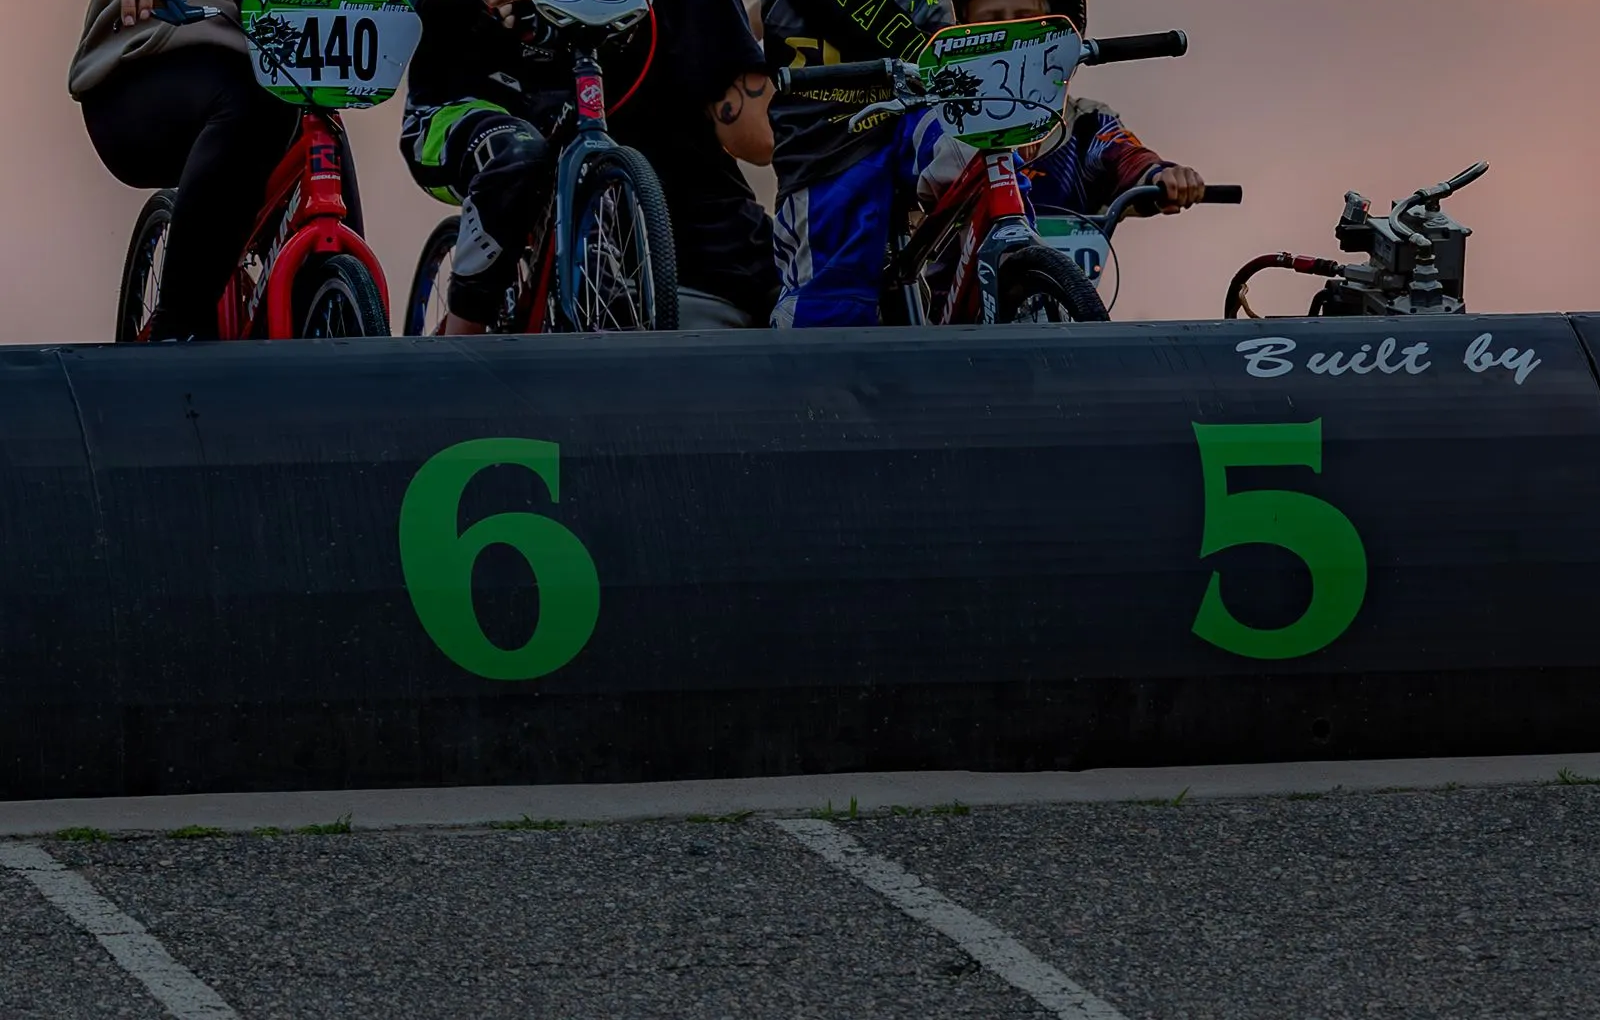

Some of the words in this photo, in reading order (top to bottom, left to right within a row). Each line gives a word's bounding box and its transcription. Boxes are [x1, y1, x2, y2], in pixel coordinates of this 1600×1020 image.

[295, 15, 379, 82] 440
[345, 86, 380, 97] 2022
[1236, 332, 1430, 378] Built
[1464, 333, 1541, 384] by
[400, 438, 599, 681] 6
[1192, 417, 1367, 659] 5
